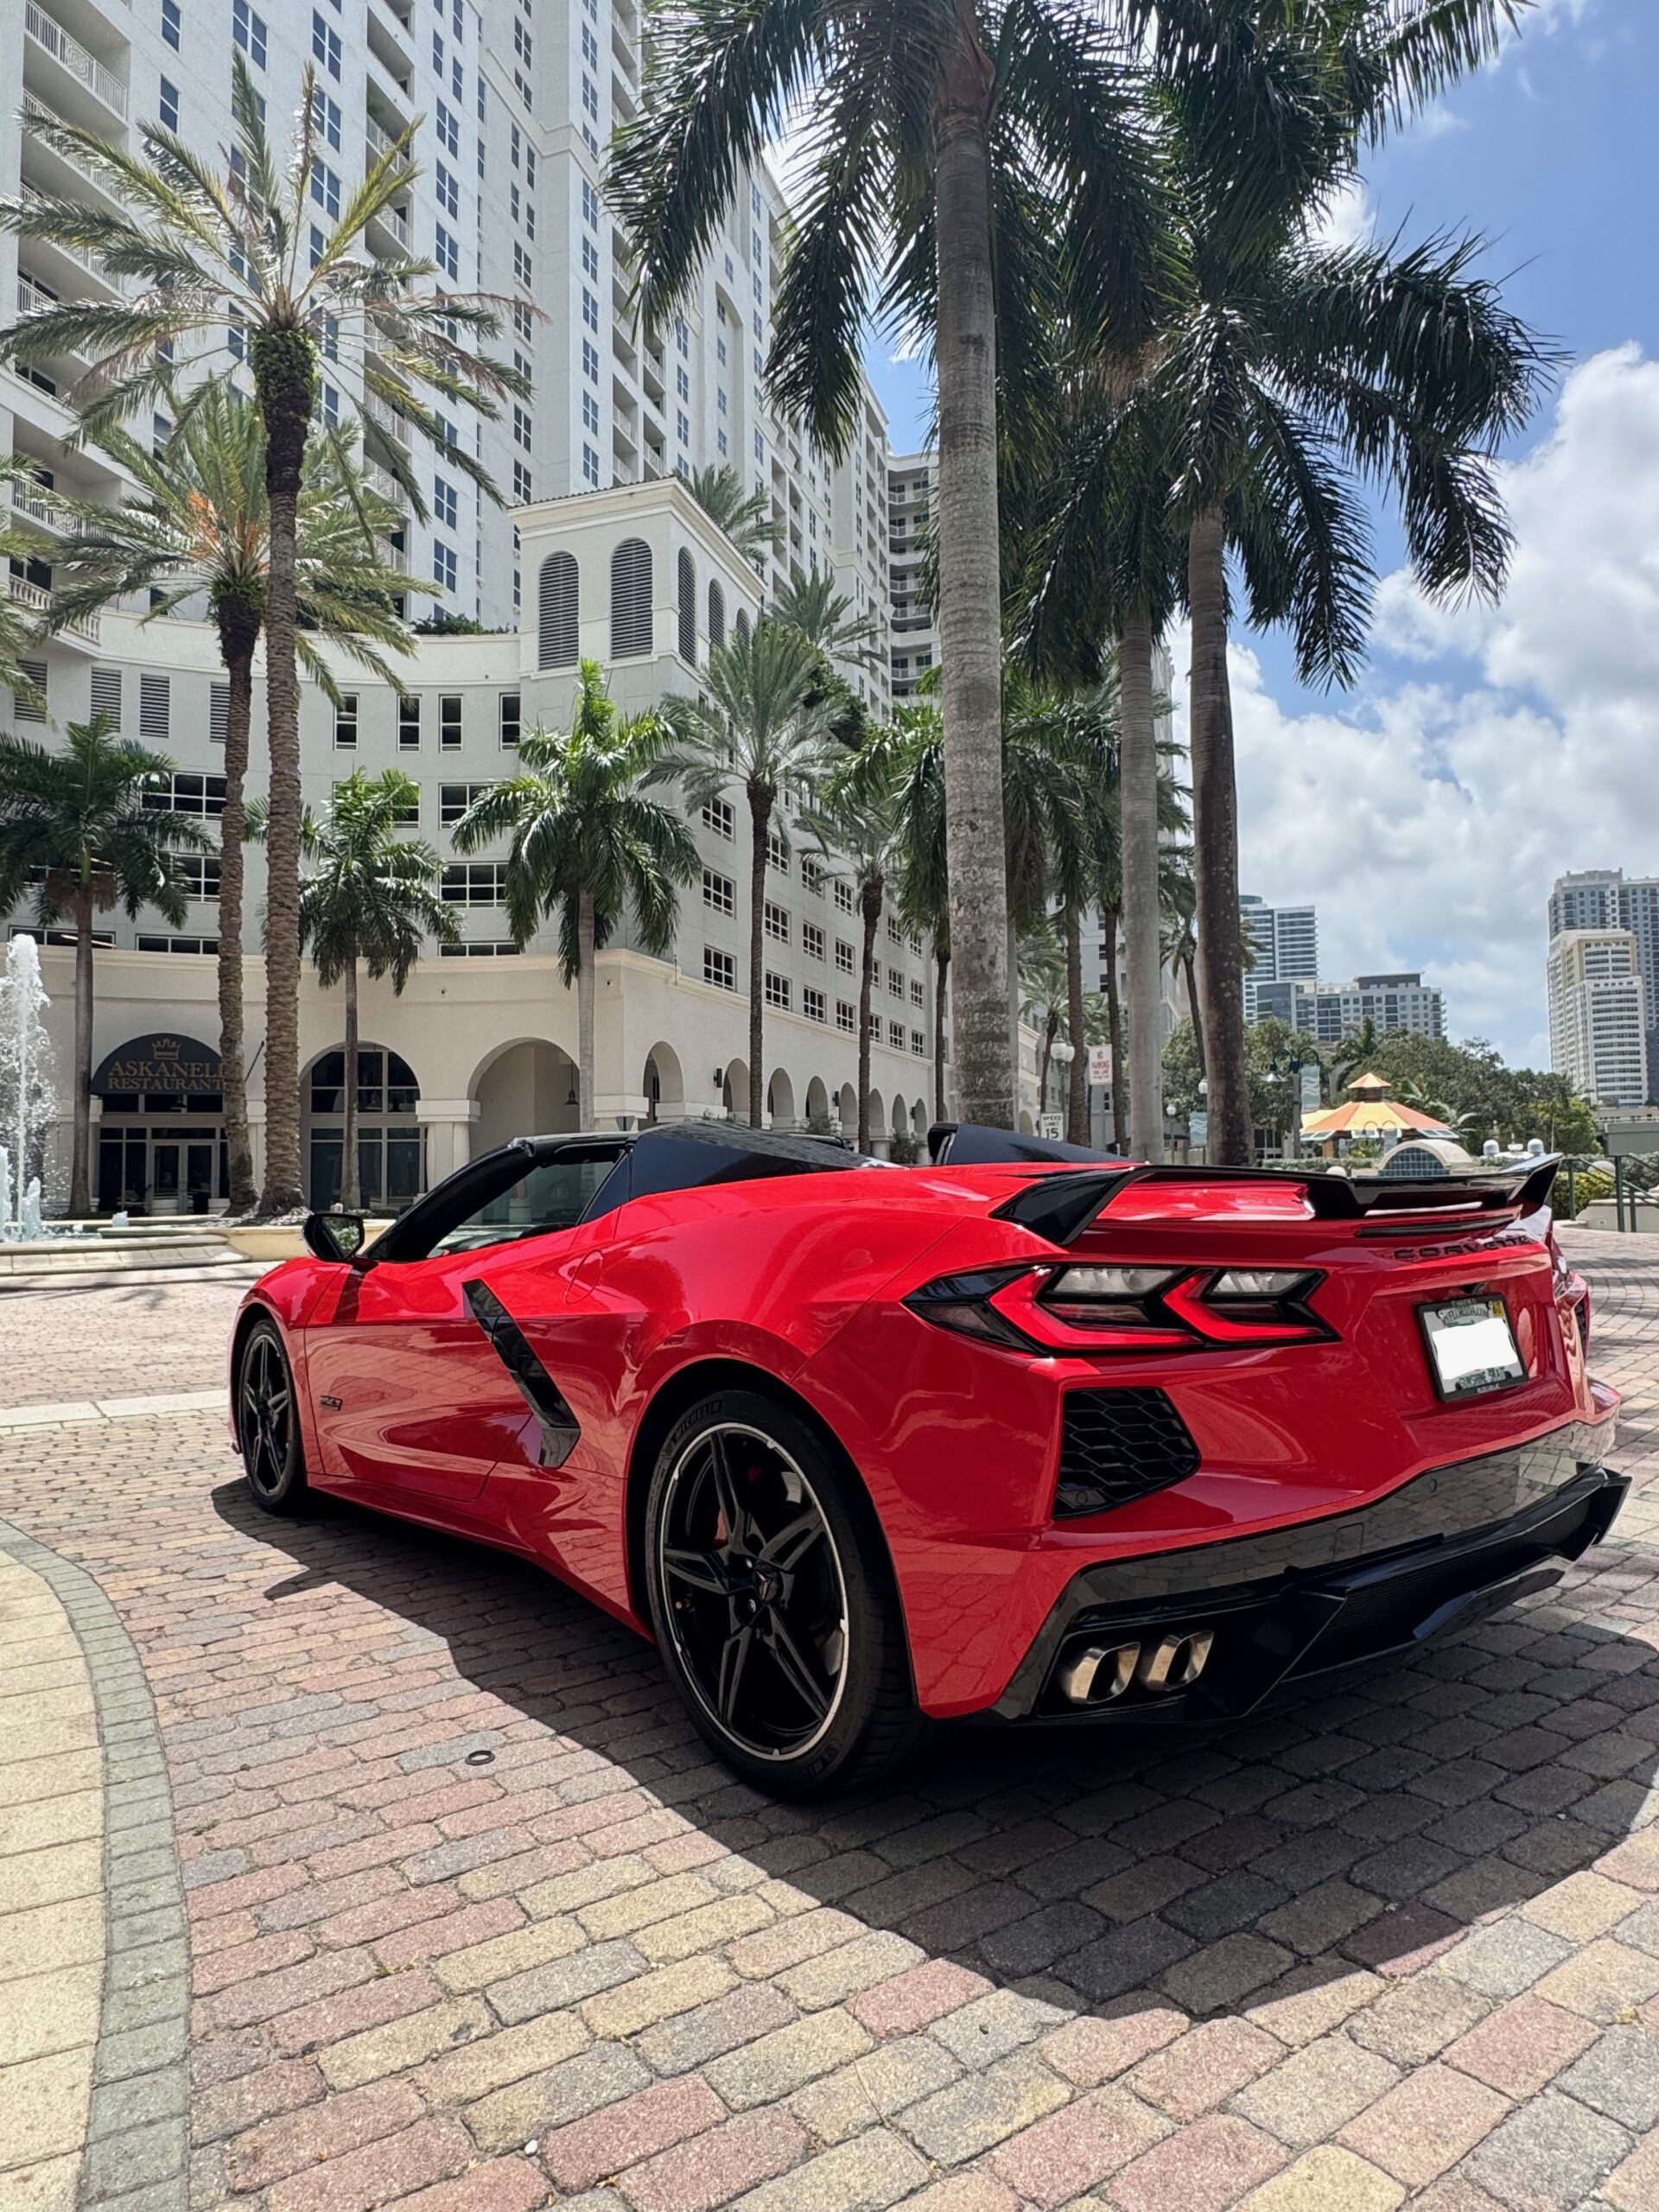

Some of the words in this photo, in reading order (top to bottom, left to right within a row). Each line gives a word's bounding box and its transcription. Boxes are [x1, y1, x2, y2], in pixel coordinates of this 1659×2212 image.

[108, 1077, 224, 1090] RESTAURANT
[1046, 1128, 1059, 1139] 15
[1394, 1235, 1530, 1259] CORVETTE
[674, 1400, 722, 1441] MICHELIN
